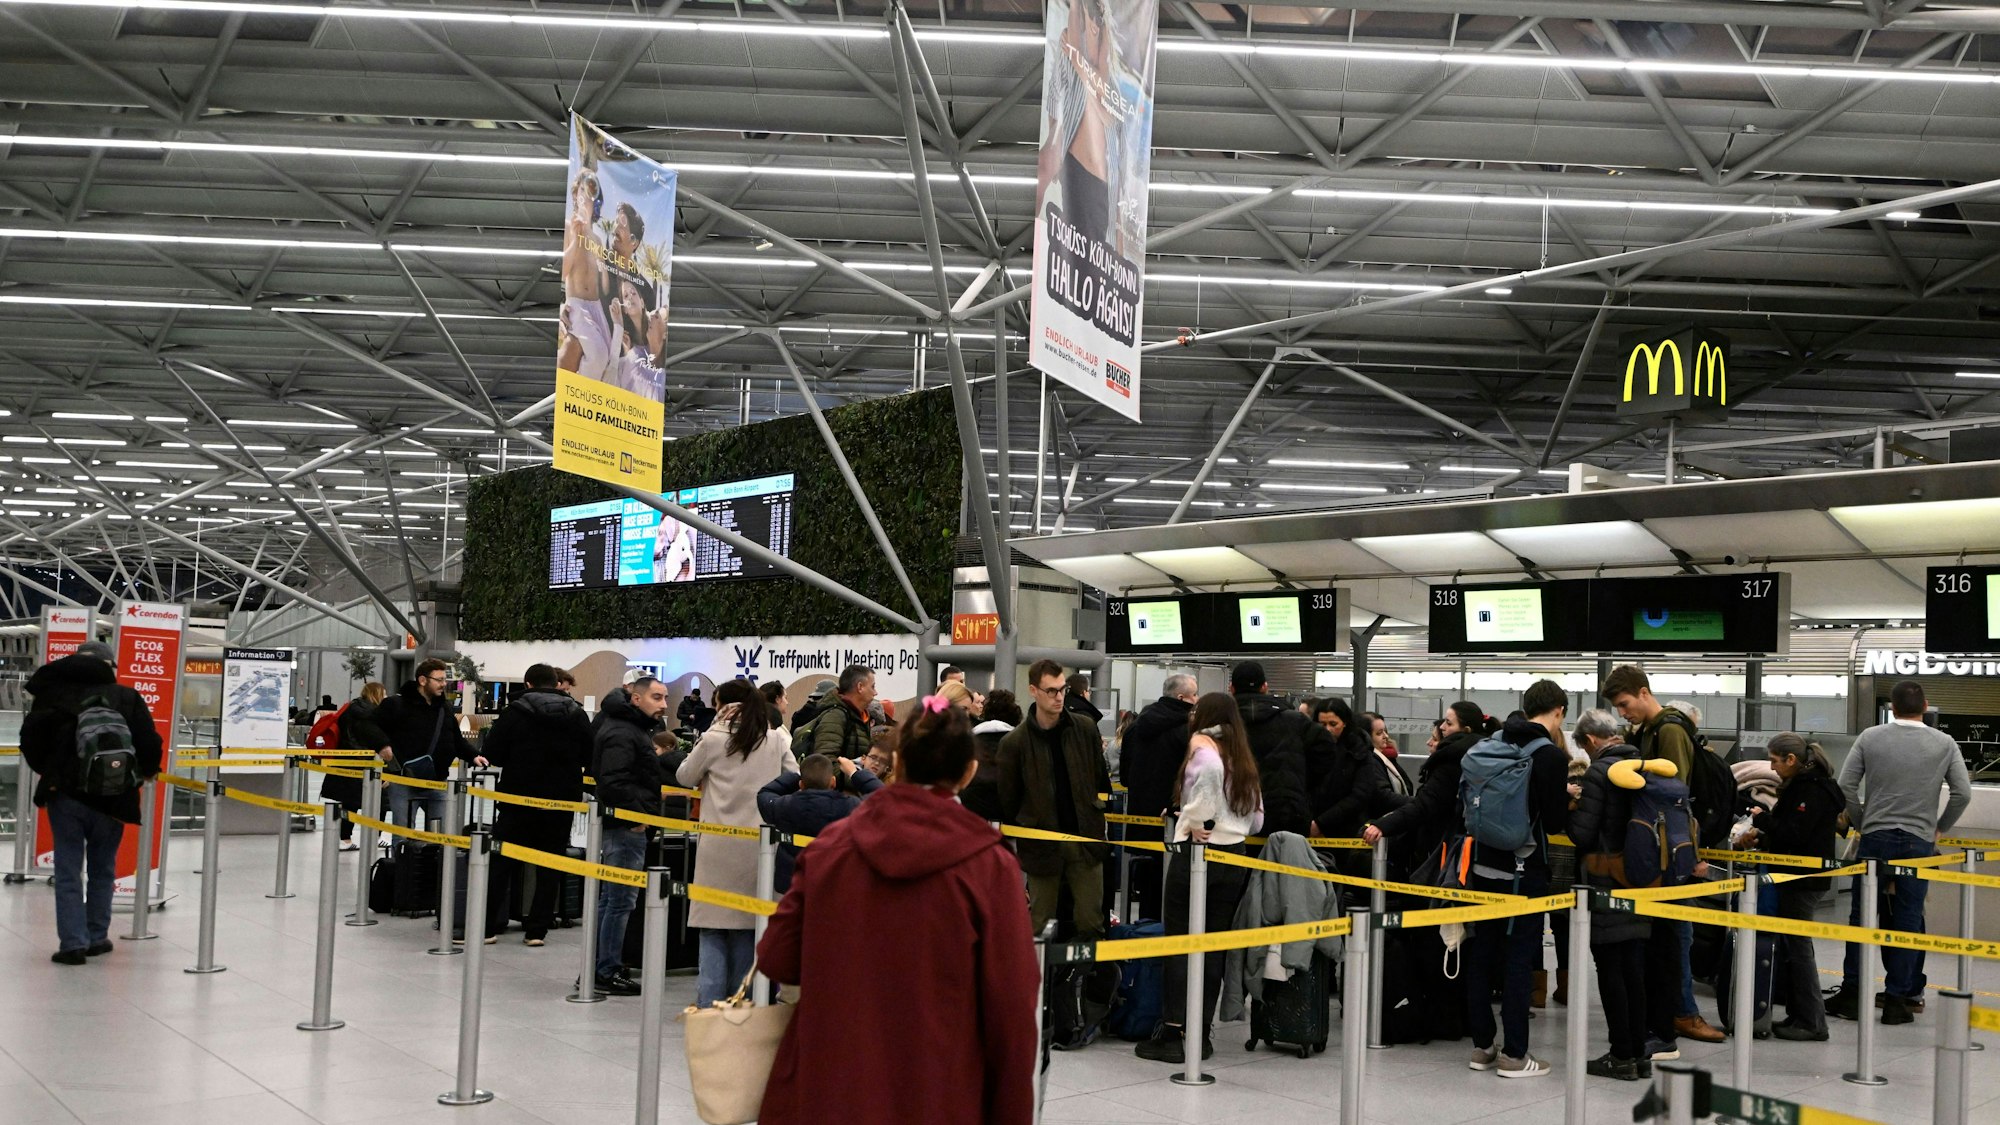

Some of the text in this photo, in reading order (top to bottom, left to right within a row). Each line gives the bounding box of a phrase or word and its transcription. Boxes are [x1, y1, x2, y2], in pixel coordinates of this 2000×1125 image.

[1050, 211, 1087, 258] TSCHÜSS
[1089, 240, 1137, 295] KÖLN-BONN.
[1050, 252, 1133, 339] HALLO ÄGÄIS!
[1045, 327, 1099, 366] ENDLICH URLAUB
[1044, 342, 1097, 378] www.bucher-reisen.de
[1106, 362, 1130, 391] BUCHER
[565, 384, 603, 406] TSCHÜSS
[564, 402, 658, 440] HALLO FAMILIENZEIT!
[561, 438, 615, 460] ENDLICH URLAUB
[633, 457, 657, 469] Neckermann
[1742, 580, 1772, 599] 317
[1935, 573, 1971, 593] 316
[1312, 594, 1333, 609] 319
[1434, 590, 1458, 606] 318
[139, 610, 179, 620] corendon
[49, 643, 80, 652] PRIORIT
[134, 640, 164, 652] ECO&
[228, 650, 275, 659] Information
[135, 652, 161, 663] FLEX
[769, 650, 830, 673] Treffpunkt
[899, 649, 919, 670] Poi
[1863, 650, 2000, 676] McDon
[130, 663, 164, 675] CLASS
[134, 682, 157, 692] BAG
[1487, 896, 1507, 904] Airport
[1894, 935, 1963, 951] Köln Bonn Airport
